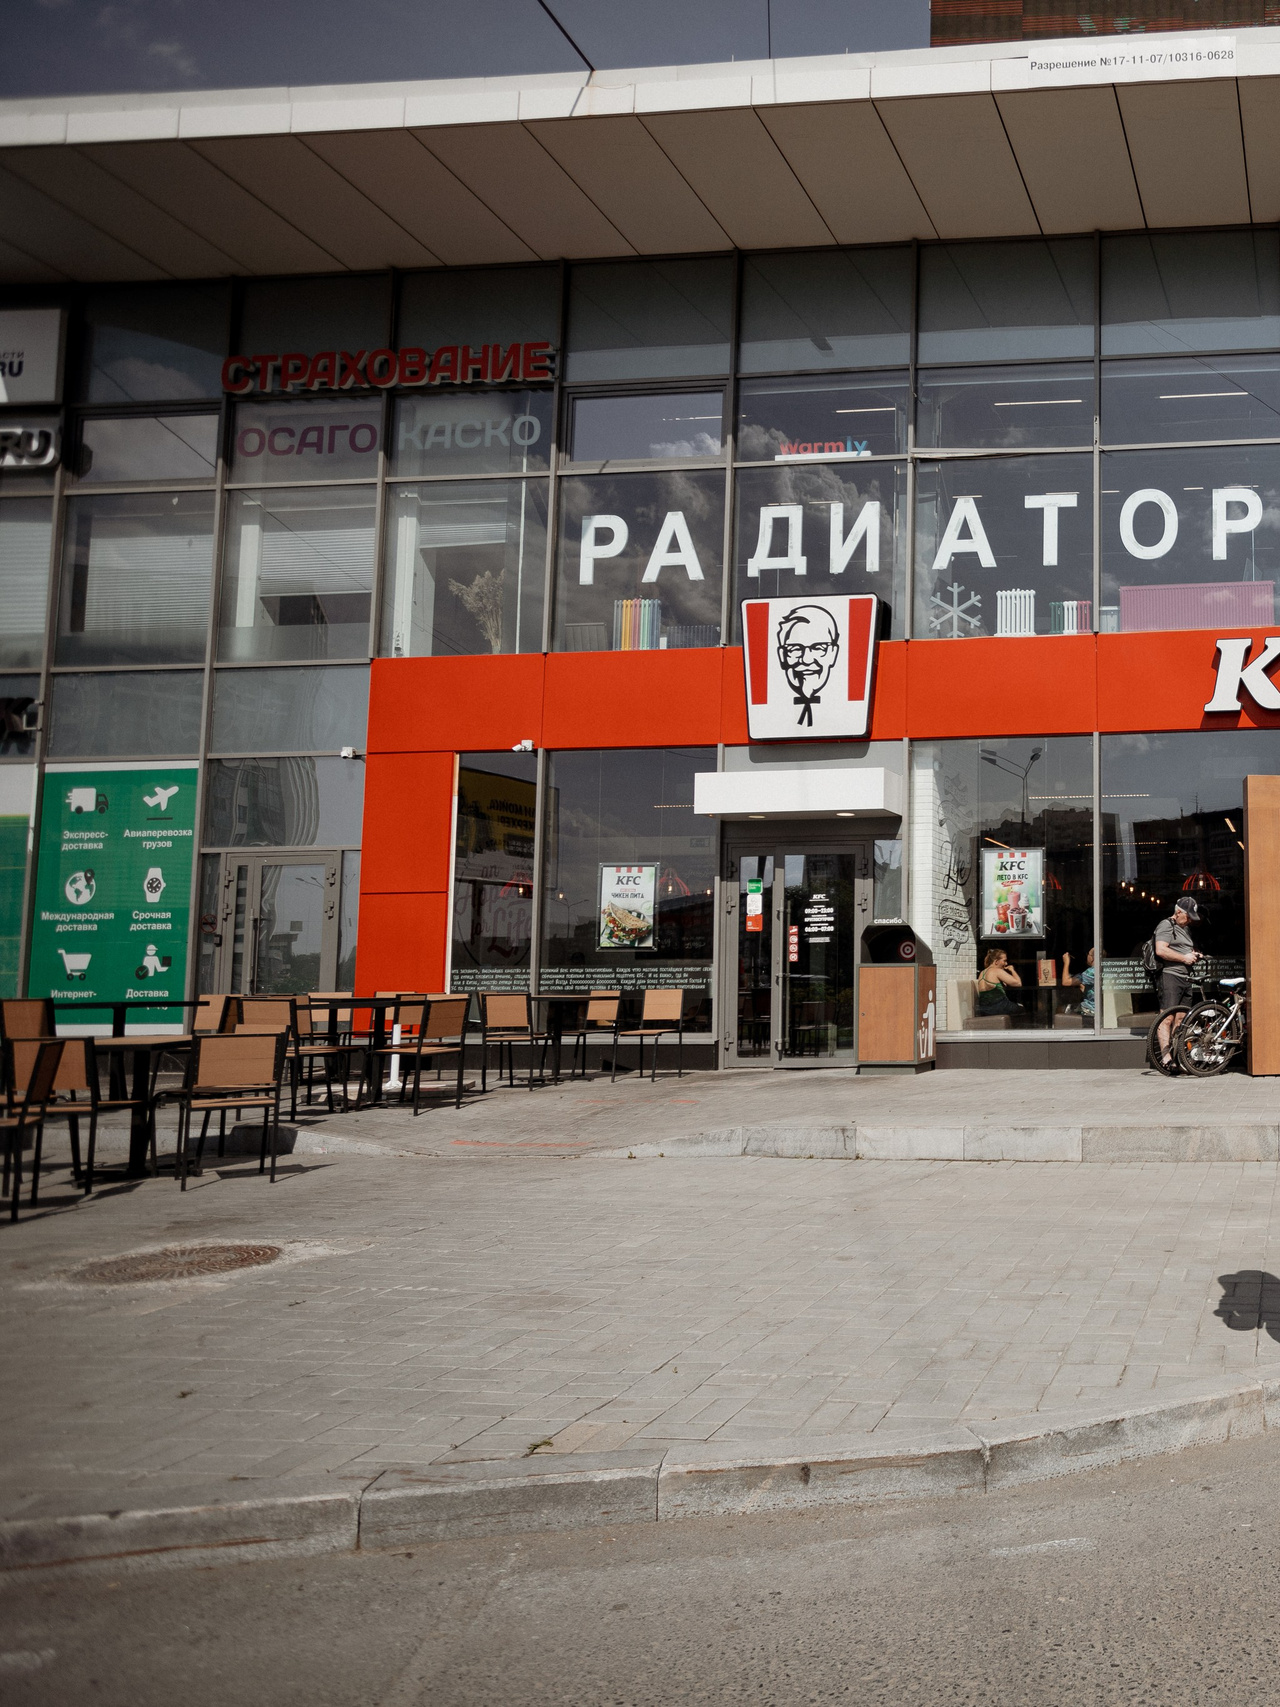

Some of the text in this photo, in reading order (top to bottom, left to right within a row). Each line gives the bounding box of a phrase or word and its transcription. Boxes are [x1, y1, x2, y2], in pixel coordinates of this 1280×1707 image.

[1030, 50, 1235, 71] Разрешение №17-11-07/10316-0628
[221, 341, 554, 393] СТРАХОВАНИЕ
[236, 415, 542, 457] ОСАГО КАСКО
[779, 436, 868, 456] warmly
[63, 830, 109, 841] Экспресс-
[123, 828, 193, 839] Авиаперевозка
[62, 841, 103, 851] доставка
[142, 840, 173, 850] грузов
[999, 860, 1026, 871] KFC
[615, 875, 641, 886] KFC
[41, 911, 115, 922] Международная
[132, 910, 172, 921] Срочная
[56, 923, 98, 933] доставка
[129, 922, 172, 931] доставка
[50, 989, 97, 999] Интернет-
[125, 988, 169, 999] Доставка
